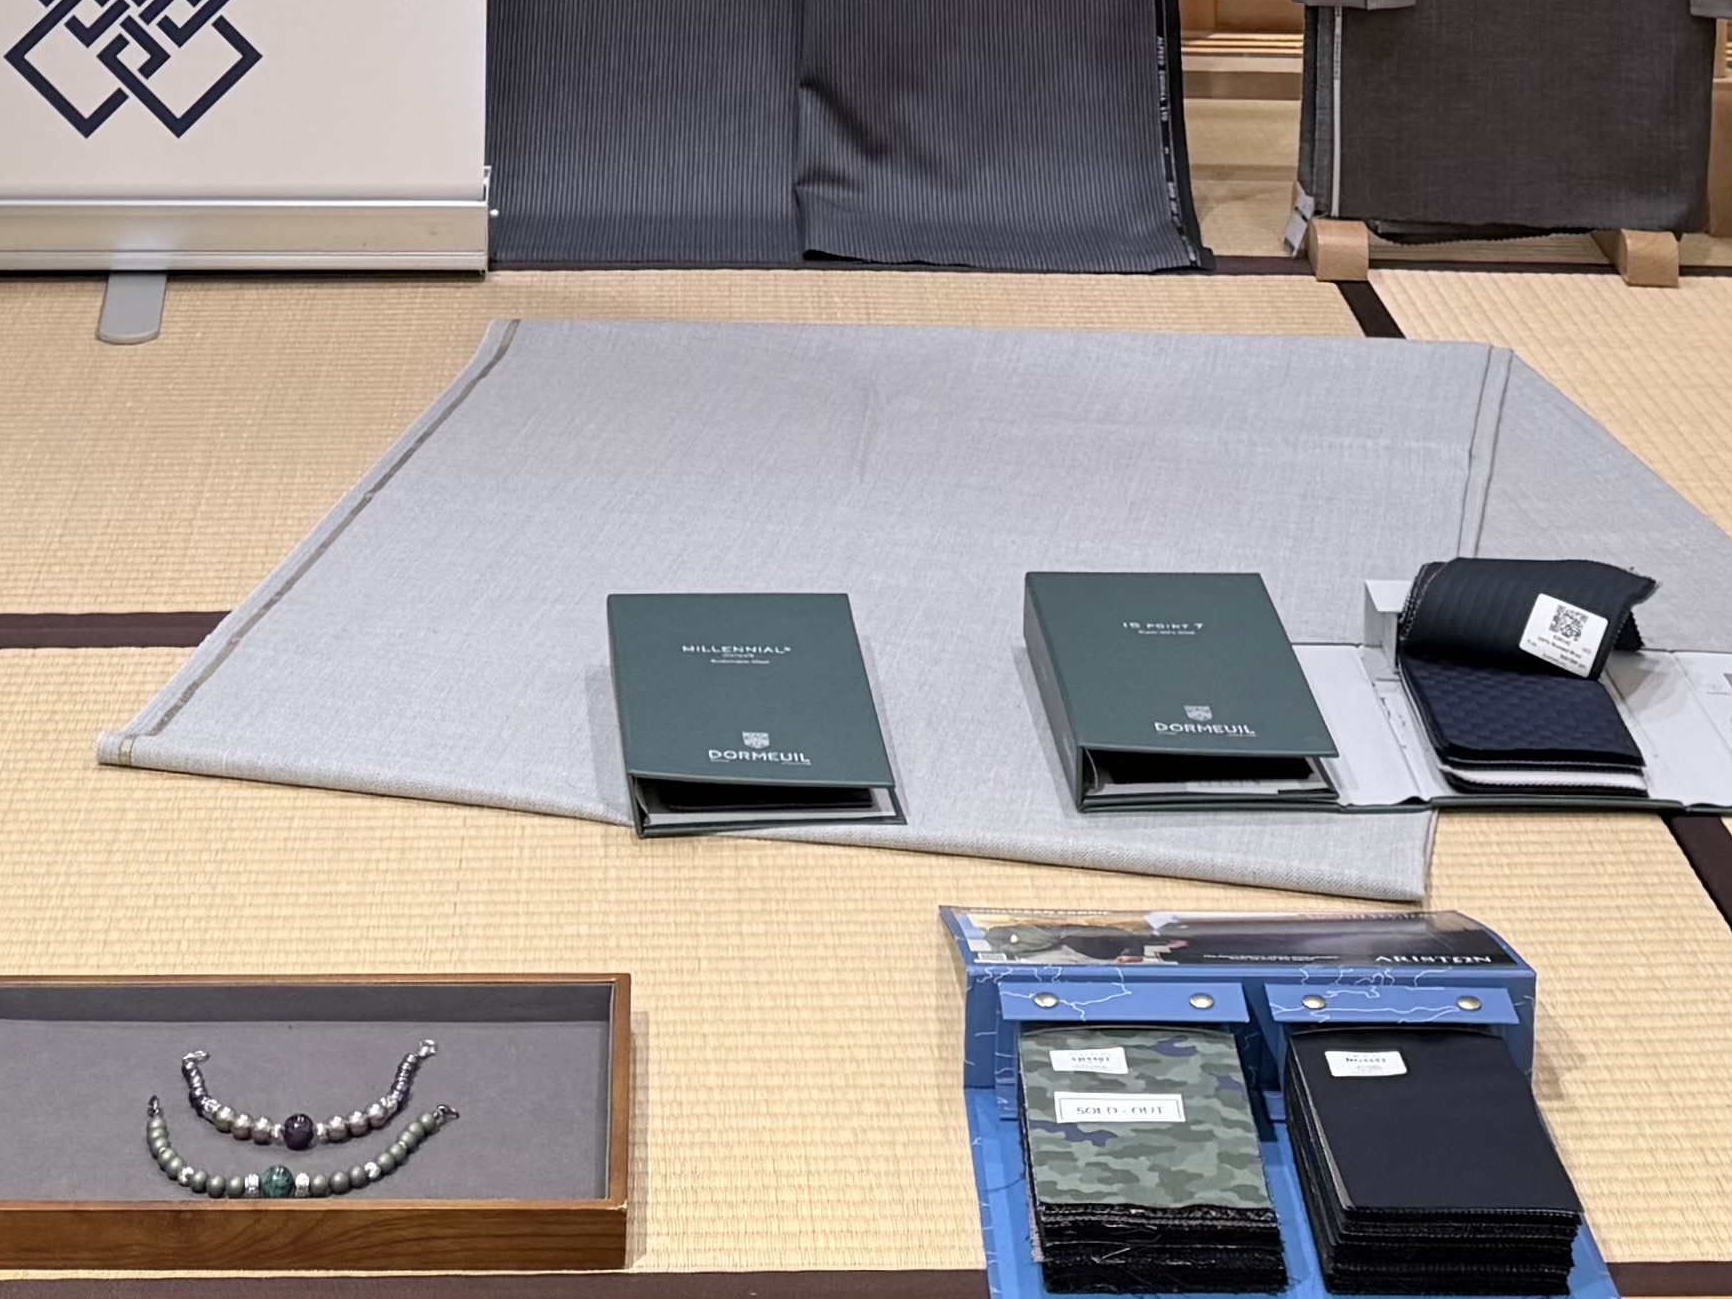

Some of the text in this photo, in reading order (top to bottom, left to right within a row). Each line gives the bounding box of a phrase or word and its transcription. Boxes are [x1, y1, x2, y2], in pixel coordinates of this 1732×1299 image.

[1154, 721, 1255, 734] DORMEUIL
[708, 749, 810, 762] DORMEUIL
[1076, 1106, 1118, 1115] SOLD
[1131, 1106, 1164, 1115] OUT
